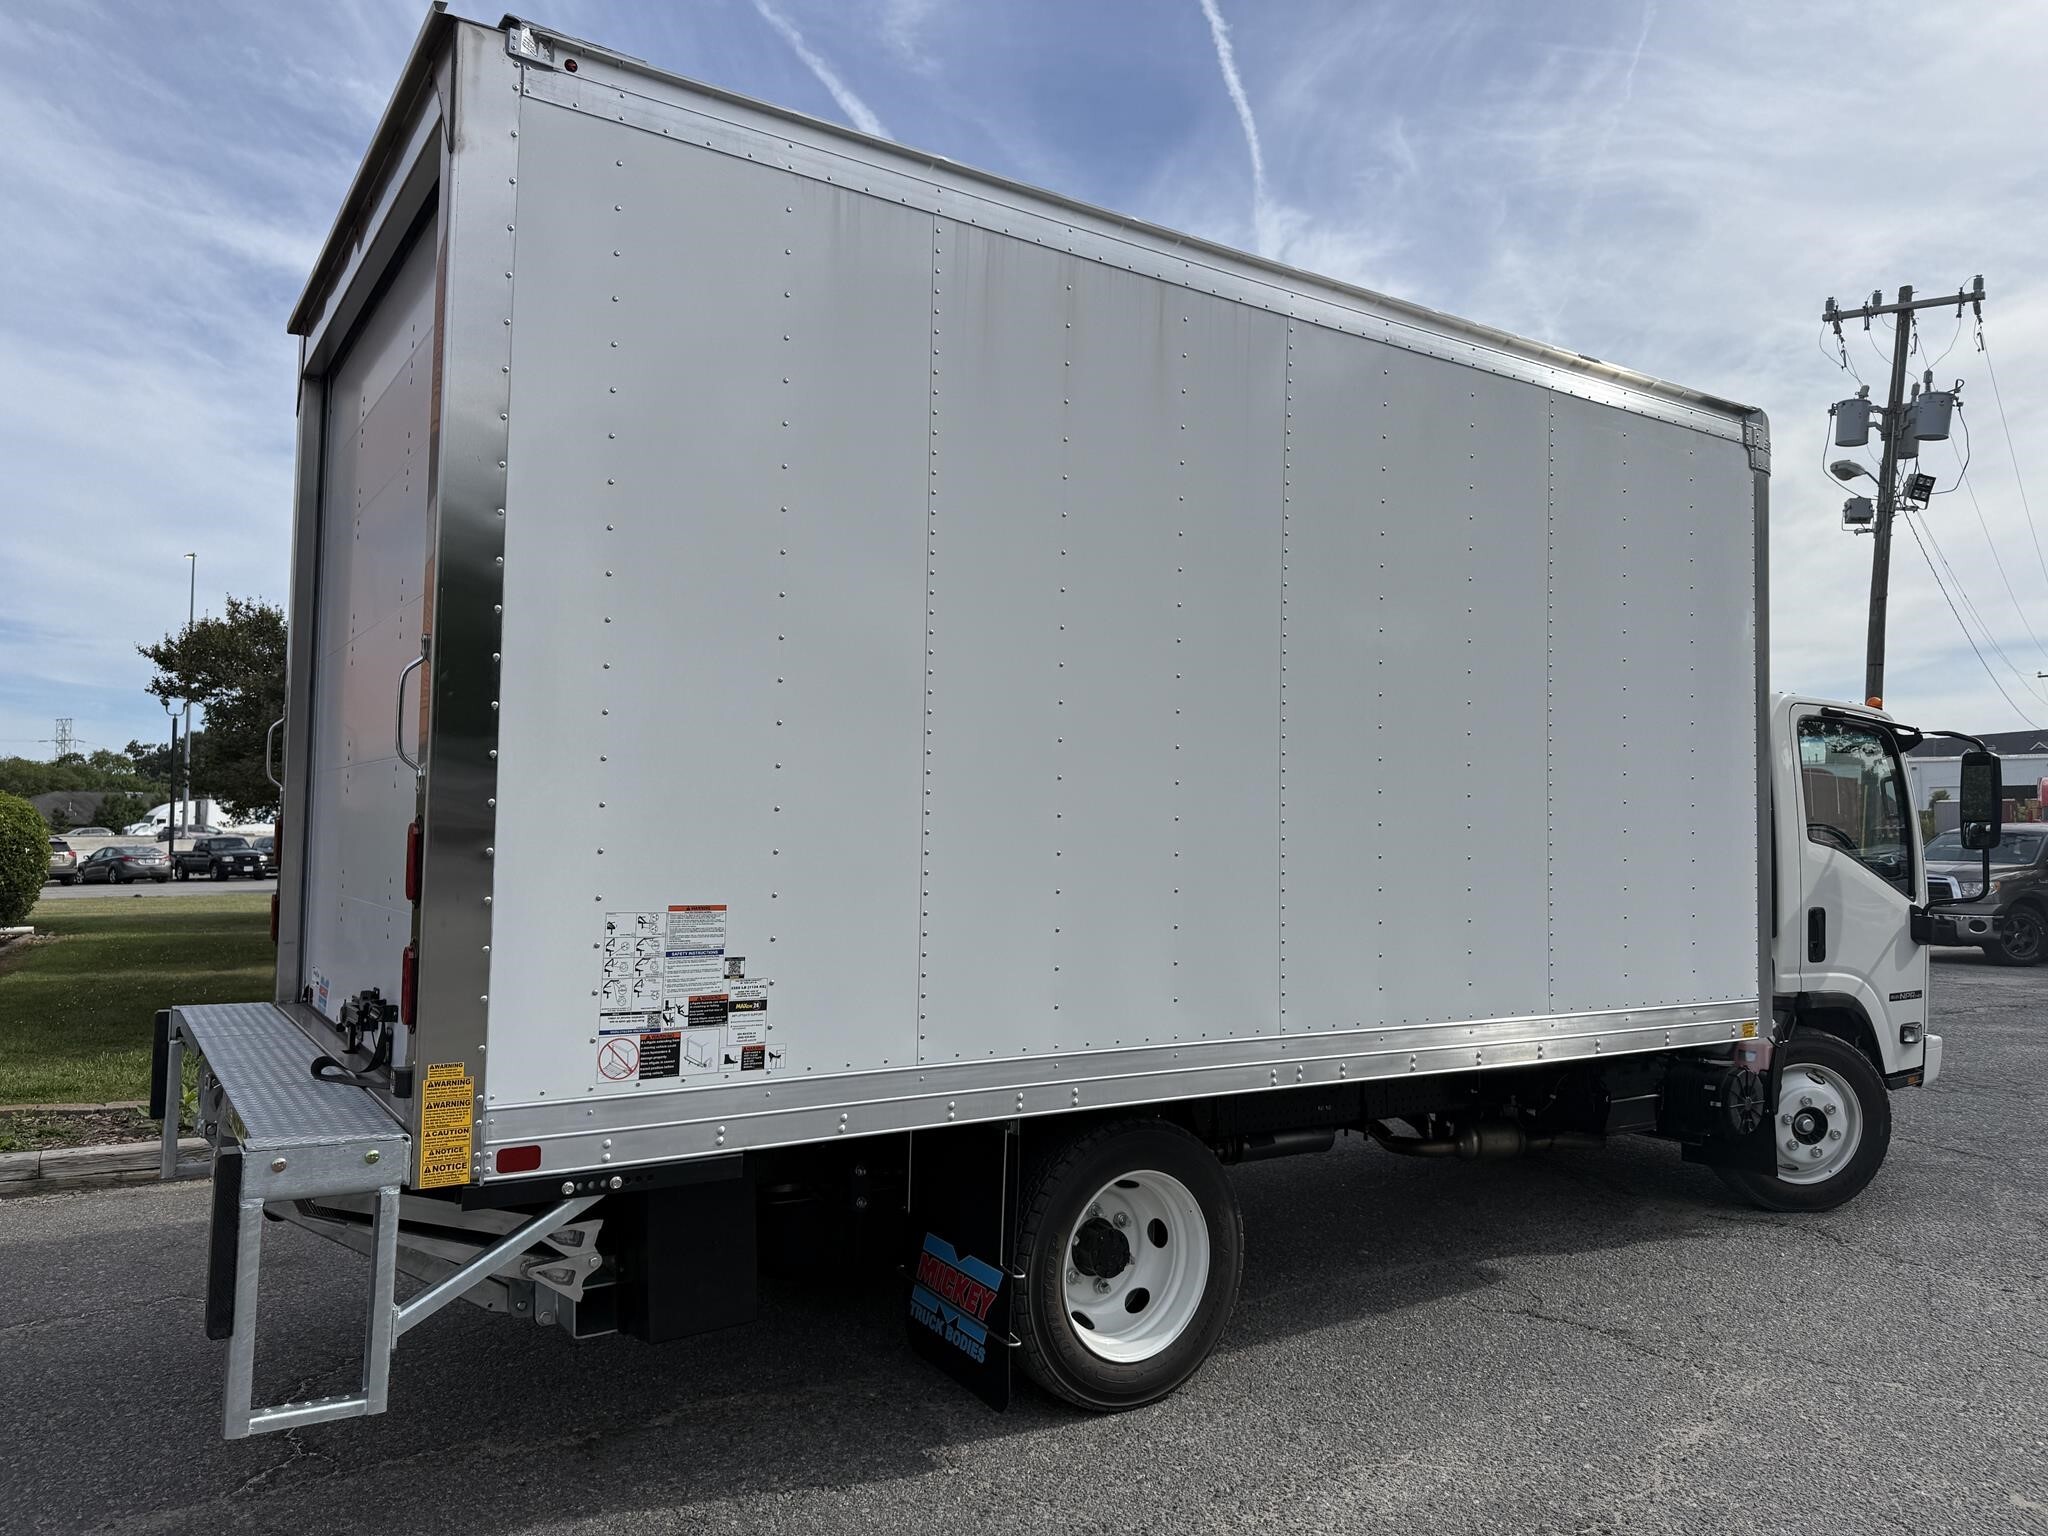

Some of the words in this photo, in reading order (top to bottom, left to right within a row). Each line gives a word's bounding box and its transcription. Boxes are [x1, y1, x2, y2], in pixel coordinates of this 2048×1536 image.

[434, 1062, 463, 1070] WARNING
[434, 1078, 471, 1087] WARNING
[433, 1099, 471, 1109] WARNING
[432, 1128, 470, 1137] CAUTION
[436, 1147, 464, 1155] NOTICE
[432, 1162, 468, 1172] NOTICE
[916, 1252, 998, 1321] MICKEY
[910, 1300, 944, 1336] TRUCK
[945, 1324, 986, 1364] BODIES
